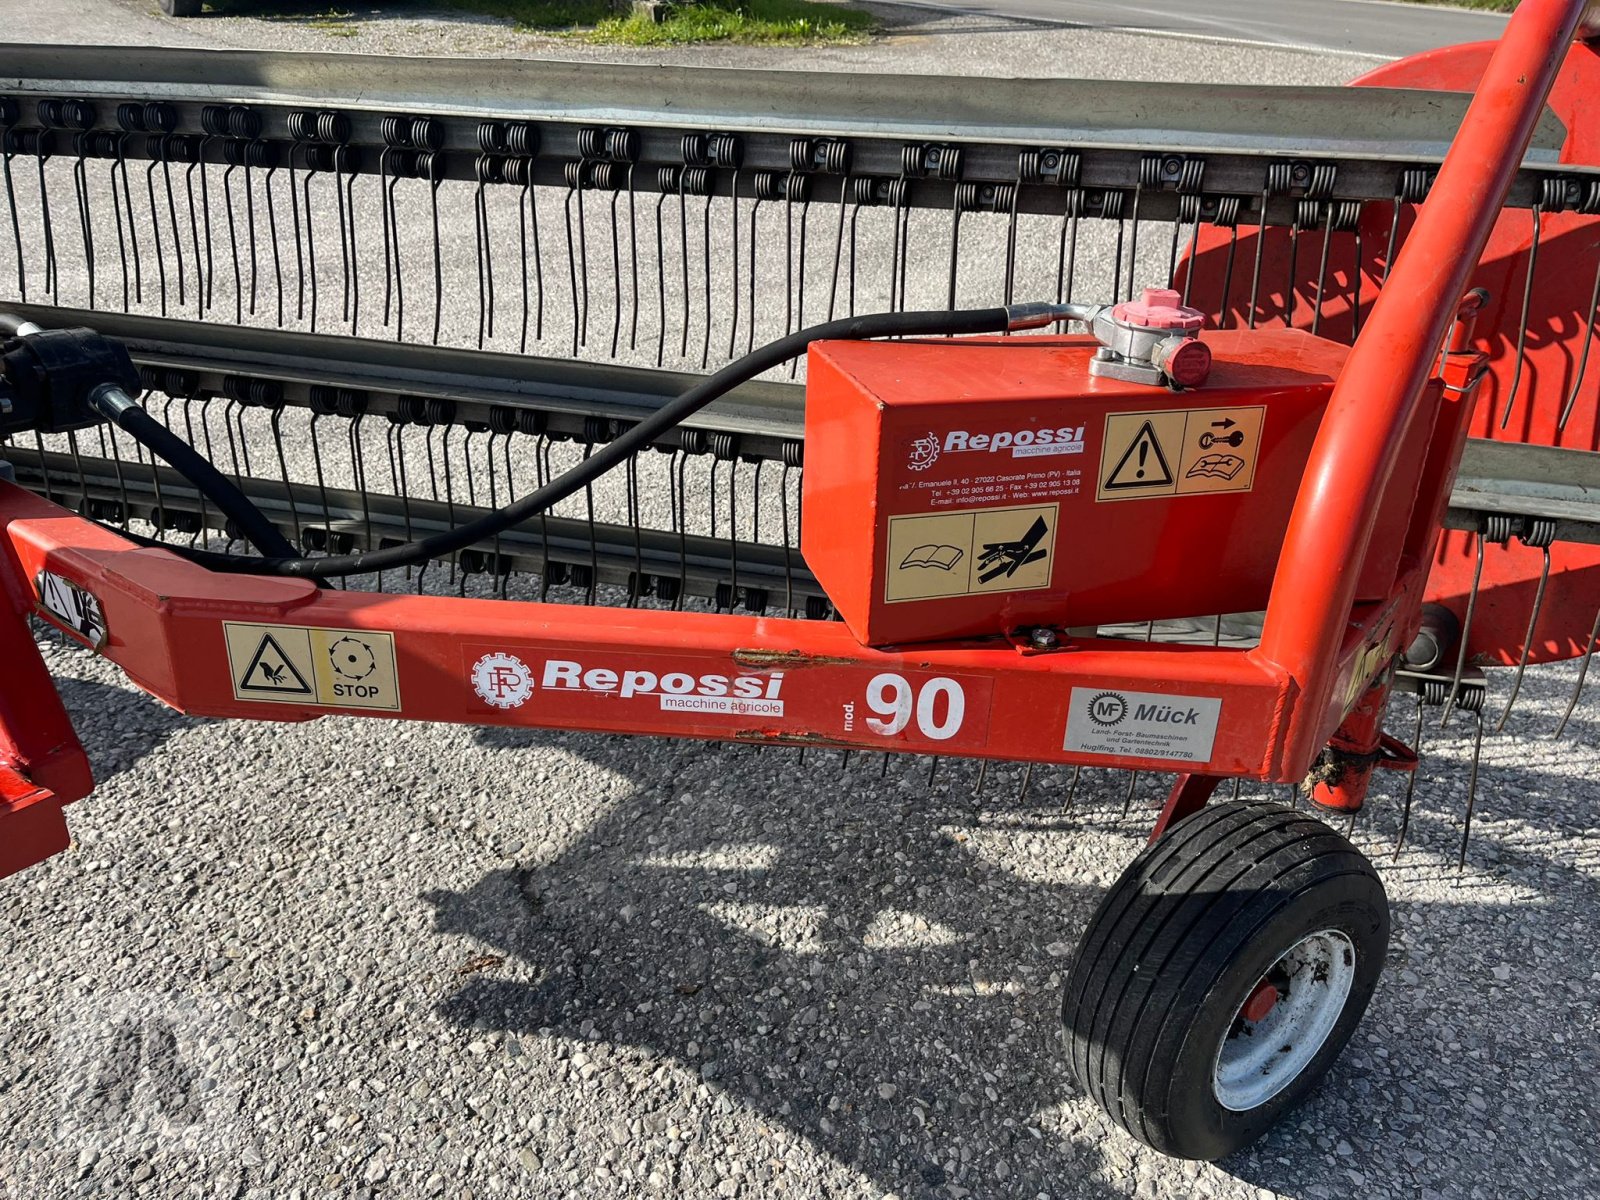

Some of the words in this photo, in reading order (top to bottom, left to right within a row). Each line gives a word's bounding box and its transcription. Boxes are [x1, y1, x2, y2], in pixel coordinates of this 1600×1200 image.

[944, 427, 1085, 452] Repossi
[1015, 446, 1052, 455] macchine
[1053, 443, 1083, 453] agricole
[918, 480, 952, 488] Emanuele
[974, 476, 995, 484] 27022
[1047, 470, 1061, 478] (PV)
[956, 494, 1007, 504] info@repossi.it
[1031, 488, 1079, 497] www.repossi.it
[542, 659, 784, 698] Repossi
[333, 683, 379, 698] STOP
[665, 696, 727, 711] macchine
[730, 701, 782, 714] agricole
[865, 672, 966, 740] 90
[1096, 702, 1121, 717] MF
[842, 701, 854, 732] mod.
[1133, 704, 1201, 725] Mück
[1091, 728, 1112, 736] Land-
[1113, 729, 1135, 737] Forst-
[1135, 732, 1188, 741] Baumaschinen
[1121, 738, 1171, 747] Gartentechnik
